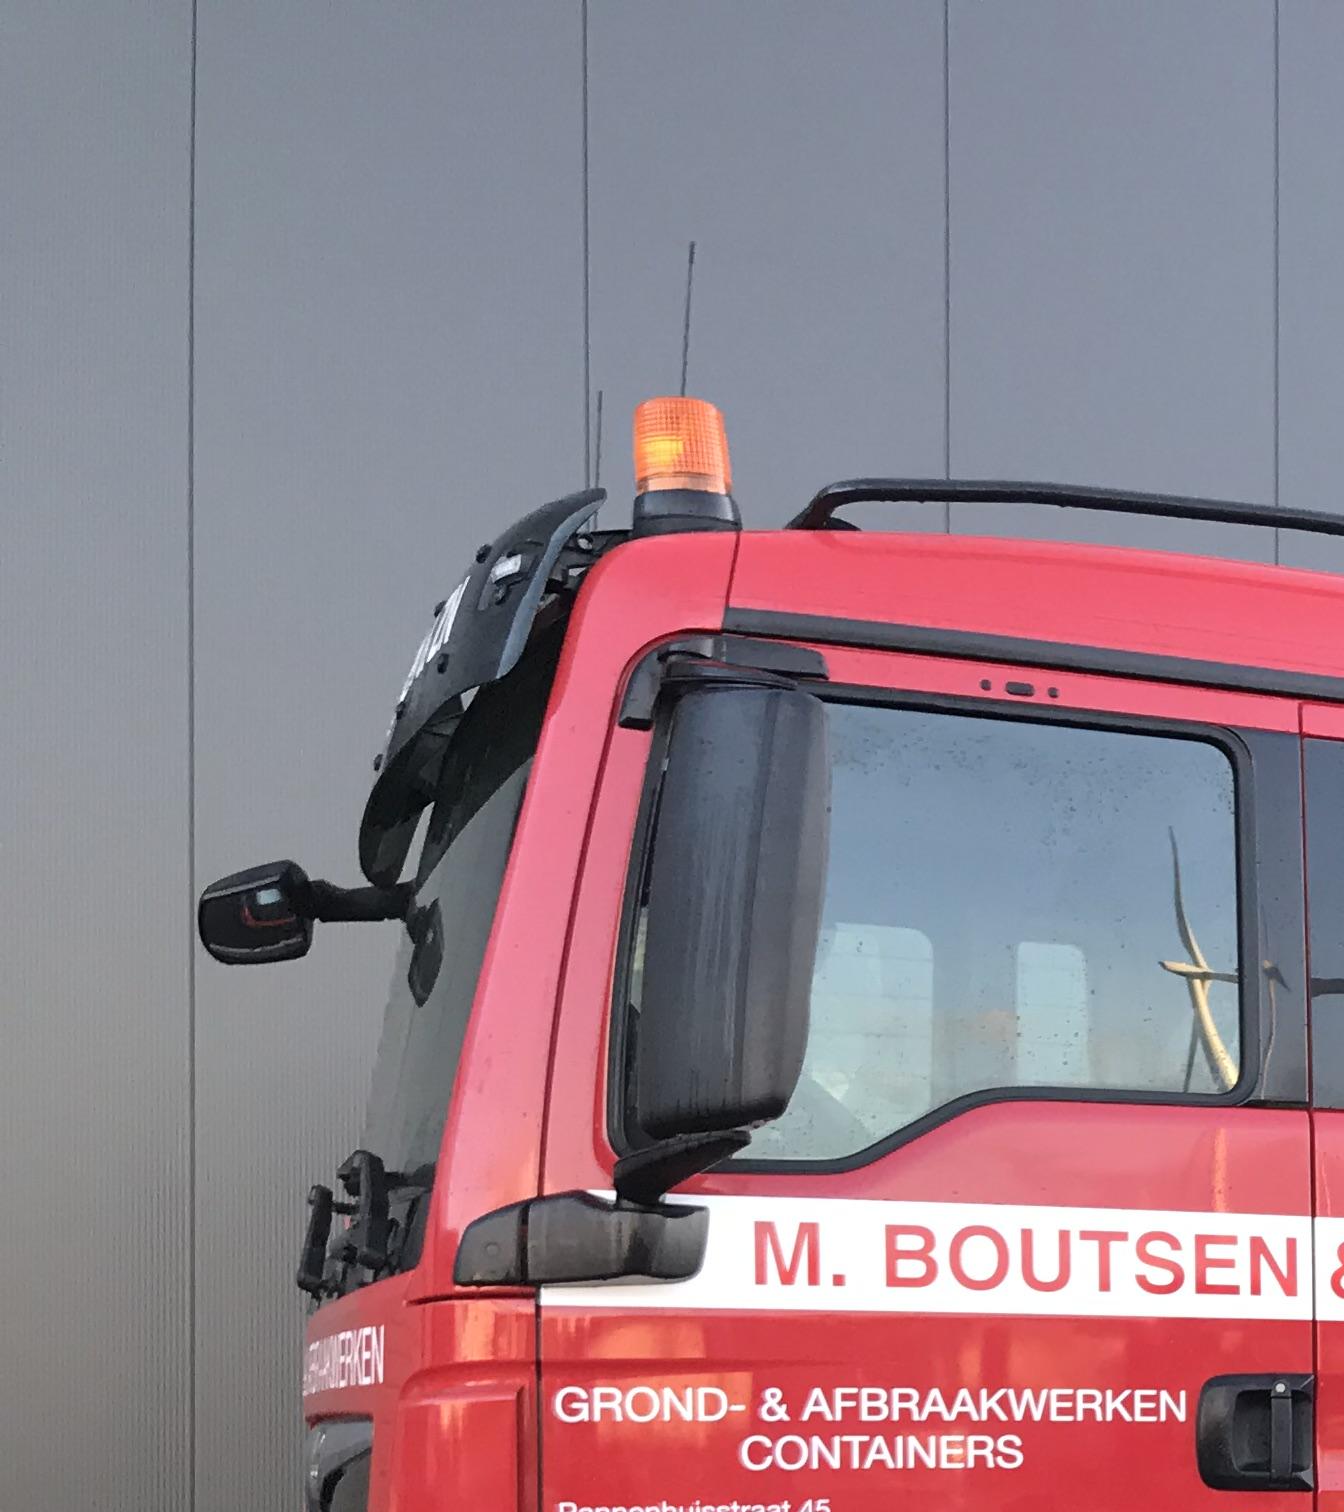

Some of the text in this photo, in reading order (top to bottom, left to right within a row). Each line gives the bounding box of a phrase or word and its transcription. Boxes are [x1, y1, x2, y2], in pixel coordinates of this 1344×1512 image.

[755, 1222, 843, 1287] M.
[886, 1226, 1296, 1297] BOUTSEN
[555, 1386, 1187, 1422] GROND- & AFBRAAKWERKEN
[741, 1435, 1024, 1470] CONTAINERS
